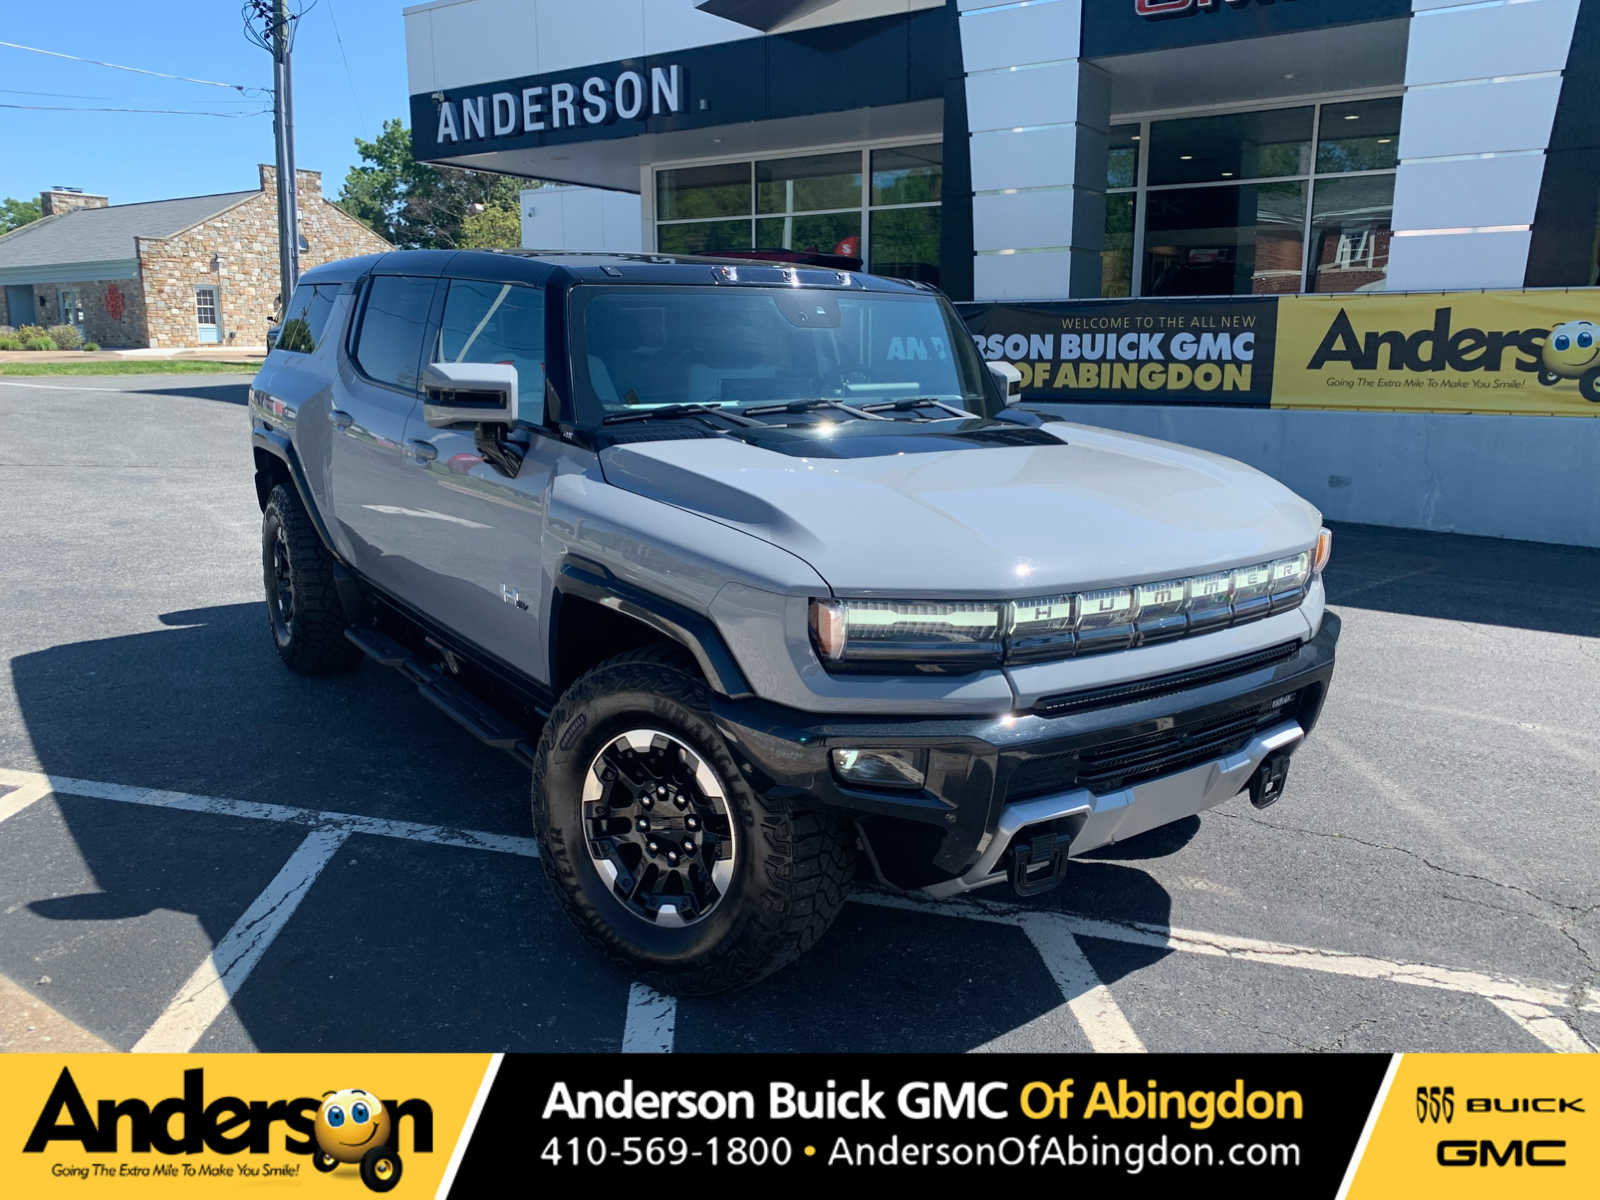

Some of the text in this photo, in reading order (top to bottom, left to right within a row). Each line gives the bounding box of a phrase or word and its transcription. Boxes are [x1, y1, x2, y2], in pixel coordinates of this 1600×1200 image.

[437, 65, 680, 143] ANDERSON
[1062, 315, 1256, 329] WELCOME TO THE ALL NEW
[1060, 332, 1166, 361] BUICK
[1169, 331, 1255, 361] GMC
[1053, 362, 1253, 391] ABINGDON
[1326, 377, 1526, 390] Going The Extra Mile To Make You Smile!
[1034, 565, 1294, 619] HUMMER
